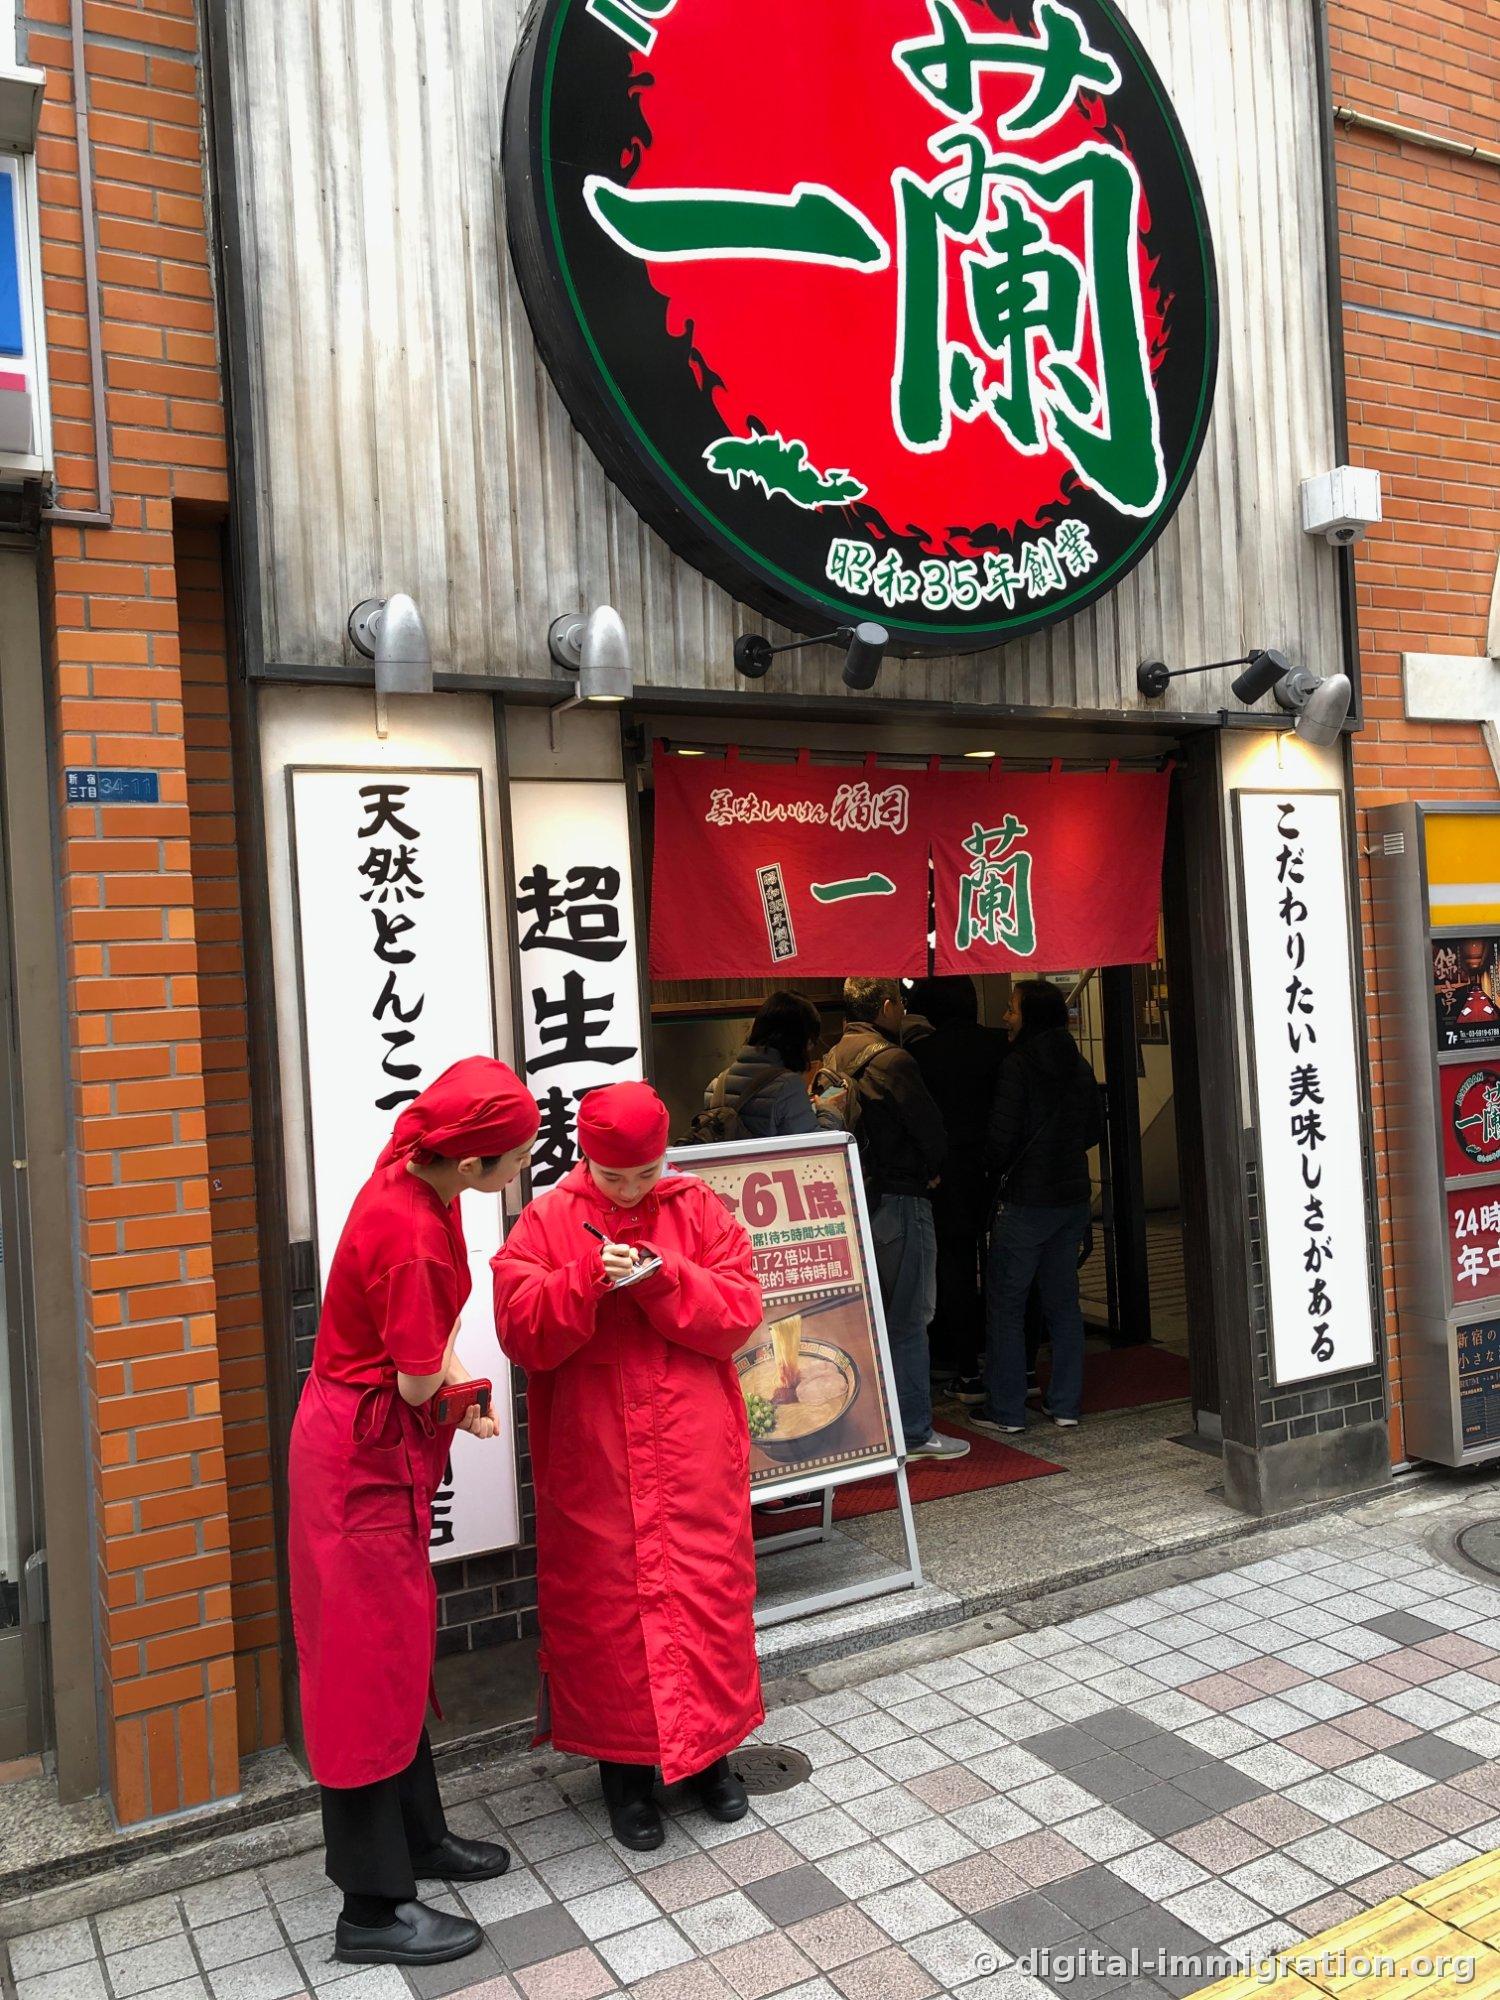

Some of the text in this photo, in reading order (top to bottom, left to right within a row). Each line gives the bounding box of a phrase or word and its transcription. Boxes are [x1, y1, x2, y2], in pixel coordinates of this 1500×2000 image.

[583, 0, 1166, 518] 一蘭
[826, 518, 1098, 611] 昭和35年創業
[68, 773, 96, 785] 新宿
[68, 786, 97, 798] 三丁目
[100, 777, 151, 796] 34-11
[810, 814, 1037, 956] 一蘭
